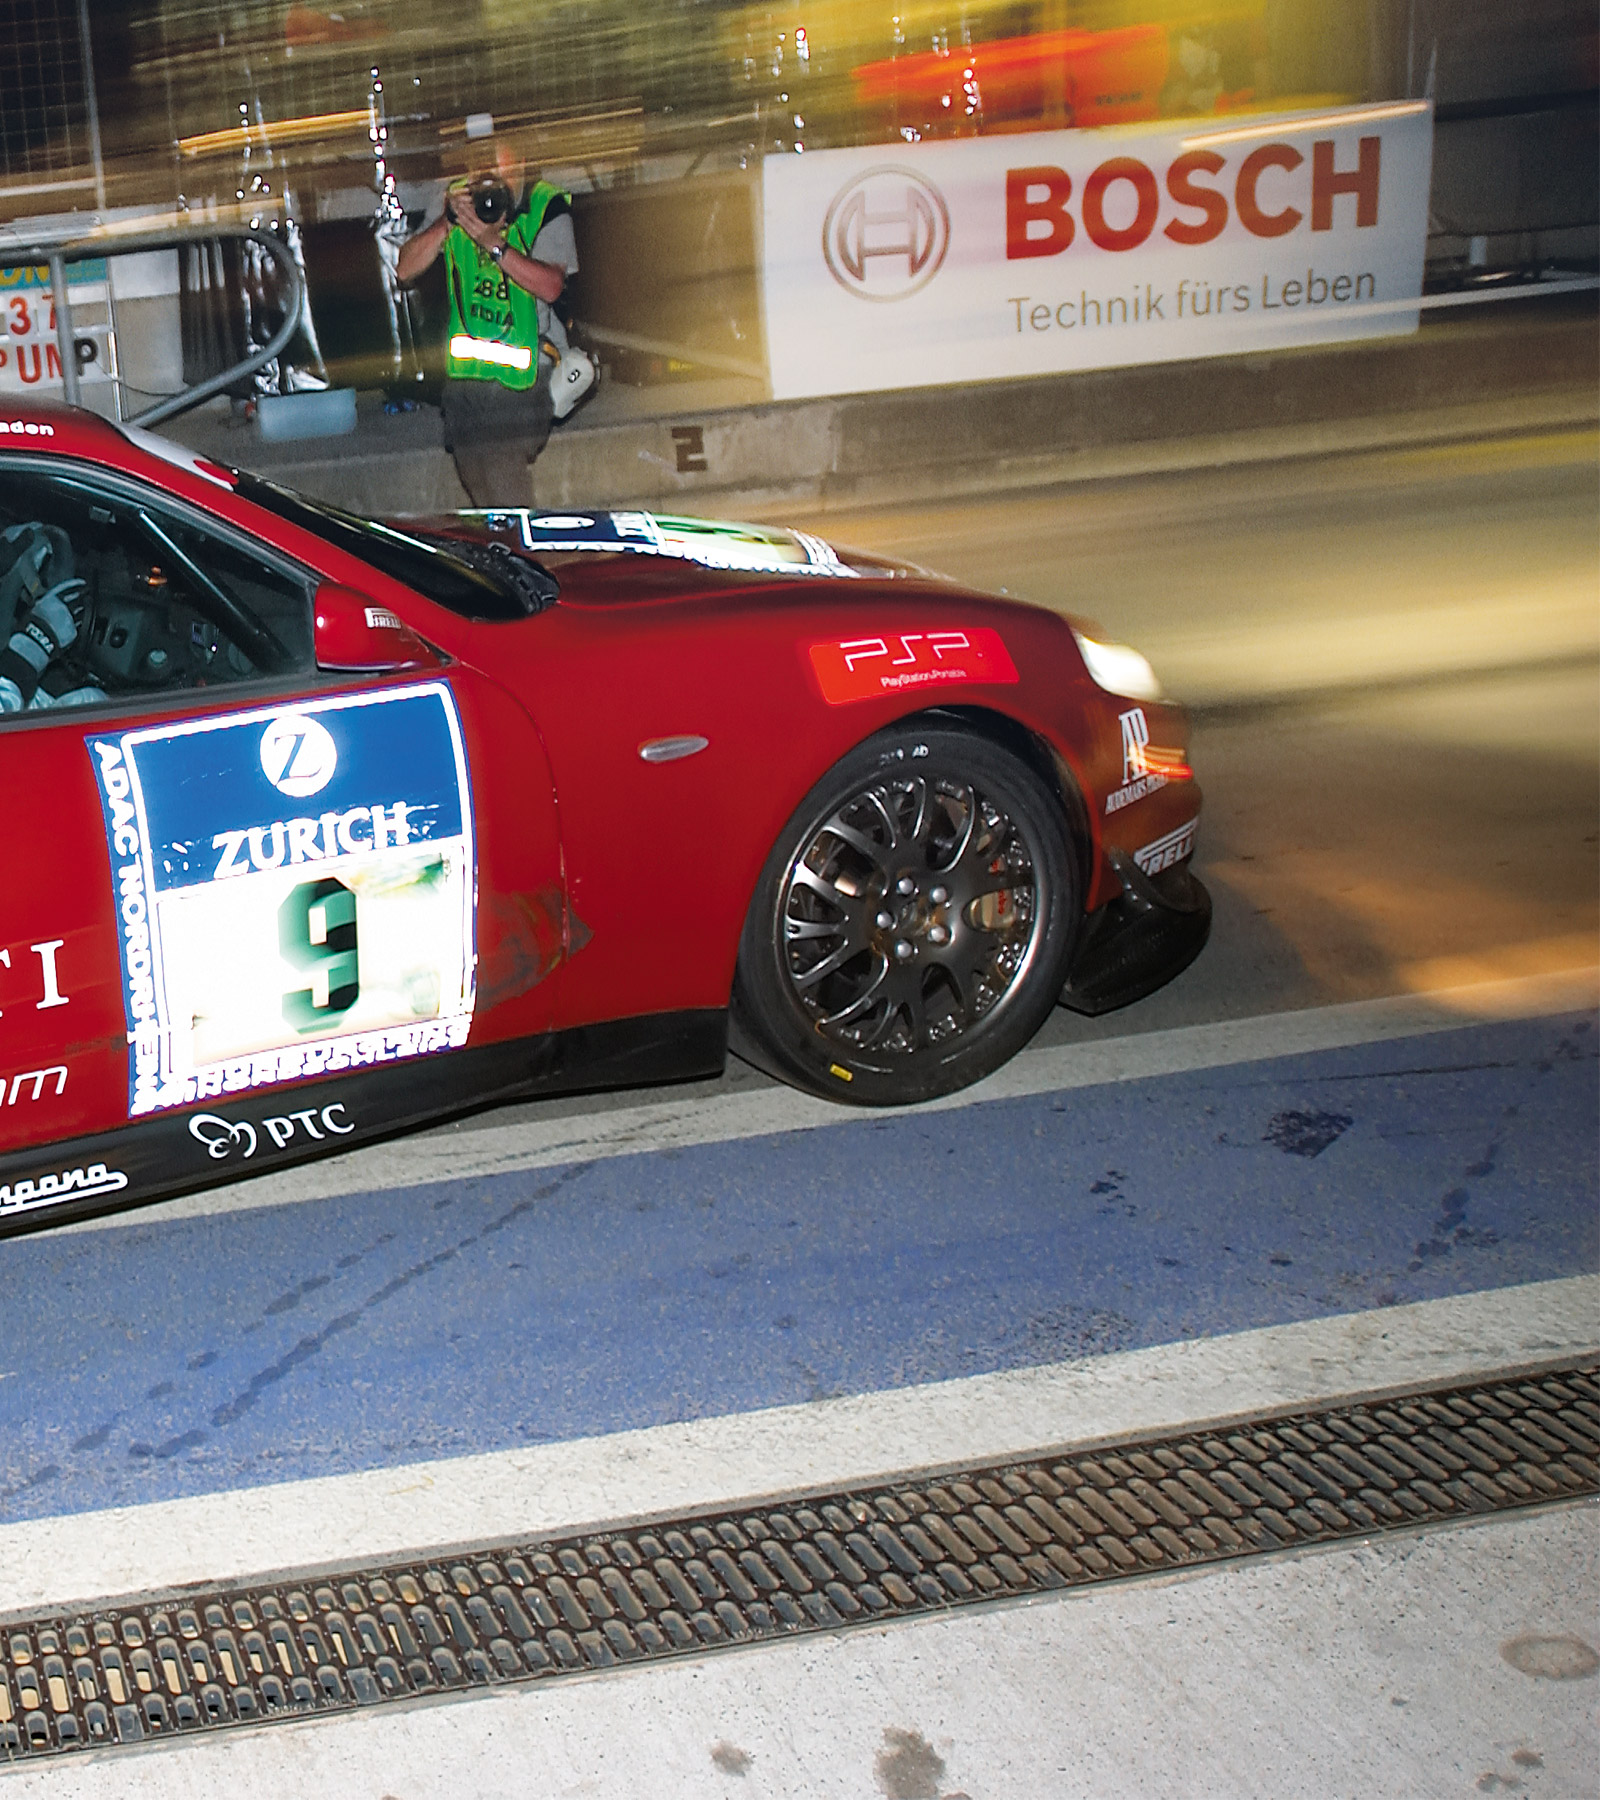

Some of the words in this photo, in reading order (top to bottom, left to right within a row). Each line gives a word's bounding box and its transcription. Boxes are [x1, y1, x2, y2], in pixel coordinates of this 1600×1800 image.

[1006, 136, 1381, 260] BOSCH
[1008, 285, 1164, 333] Technik
[1178, 279, 1250, 322] fürs
[1261, 268, 1377, 310] Leben
[840, 632, 970, 672] PSP
[94, 741, 140, 857] ADAC
[212, 801, 411, 879] ZURICH
[278, 876, 360, 1035] 9
[262, 1103, 355, 1148] PTC
